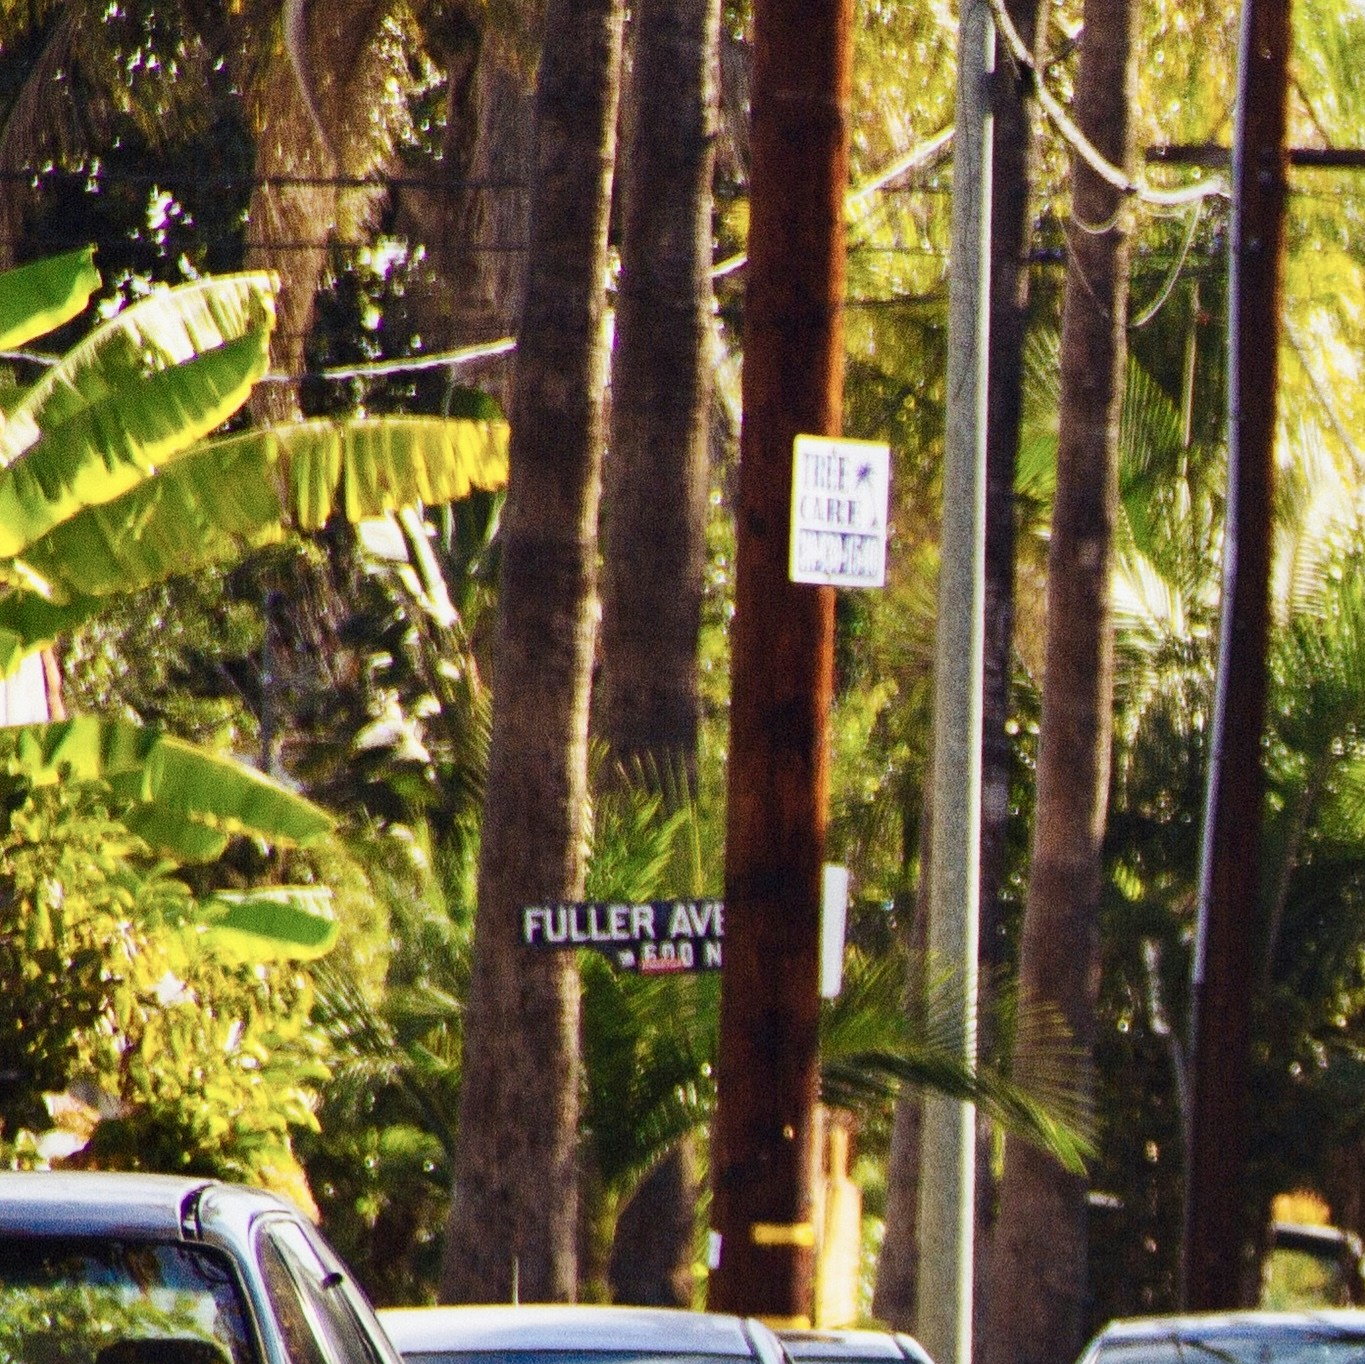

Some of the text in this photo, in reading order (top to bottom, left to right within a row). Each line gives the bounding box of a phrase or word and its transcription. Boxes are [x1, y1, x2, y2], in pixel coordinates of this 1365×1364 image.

[802, 451, 848, 492] TREE
[799, 495, 857, 526] CARE
[523, 902, 725, 943] FULLER AVE
[704, 940, 723, 968] N
